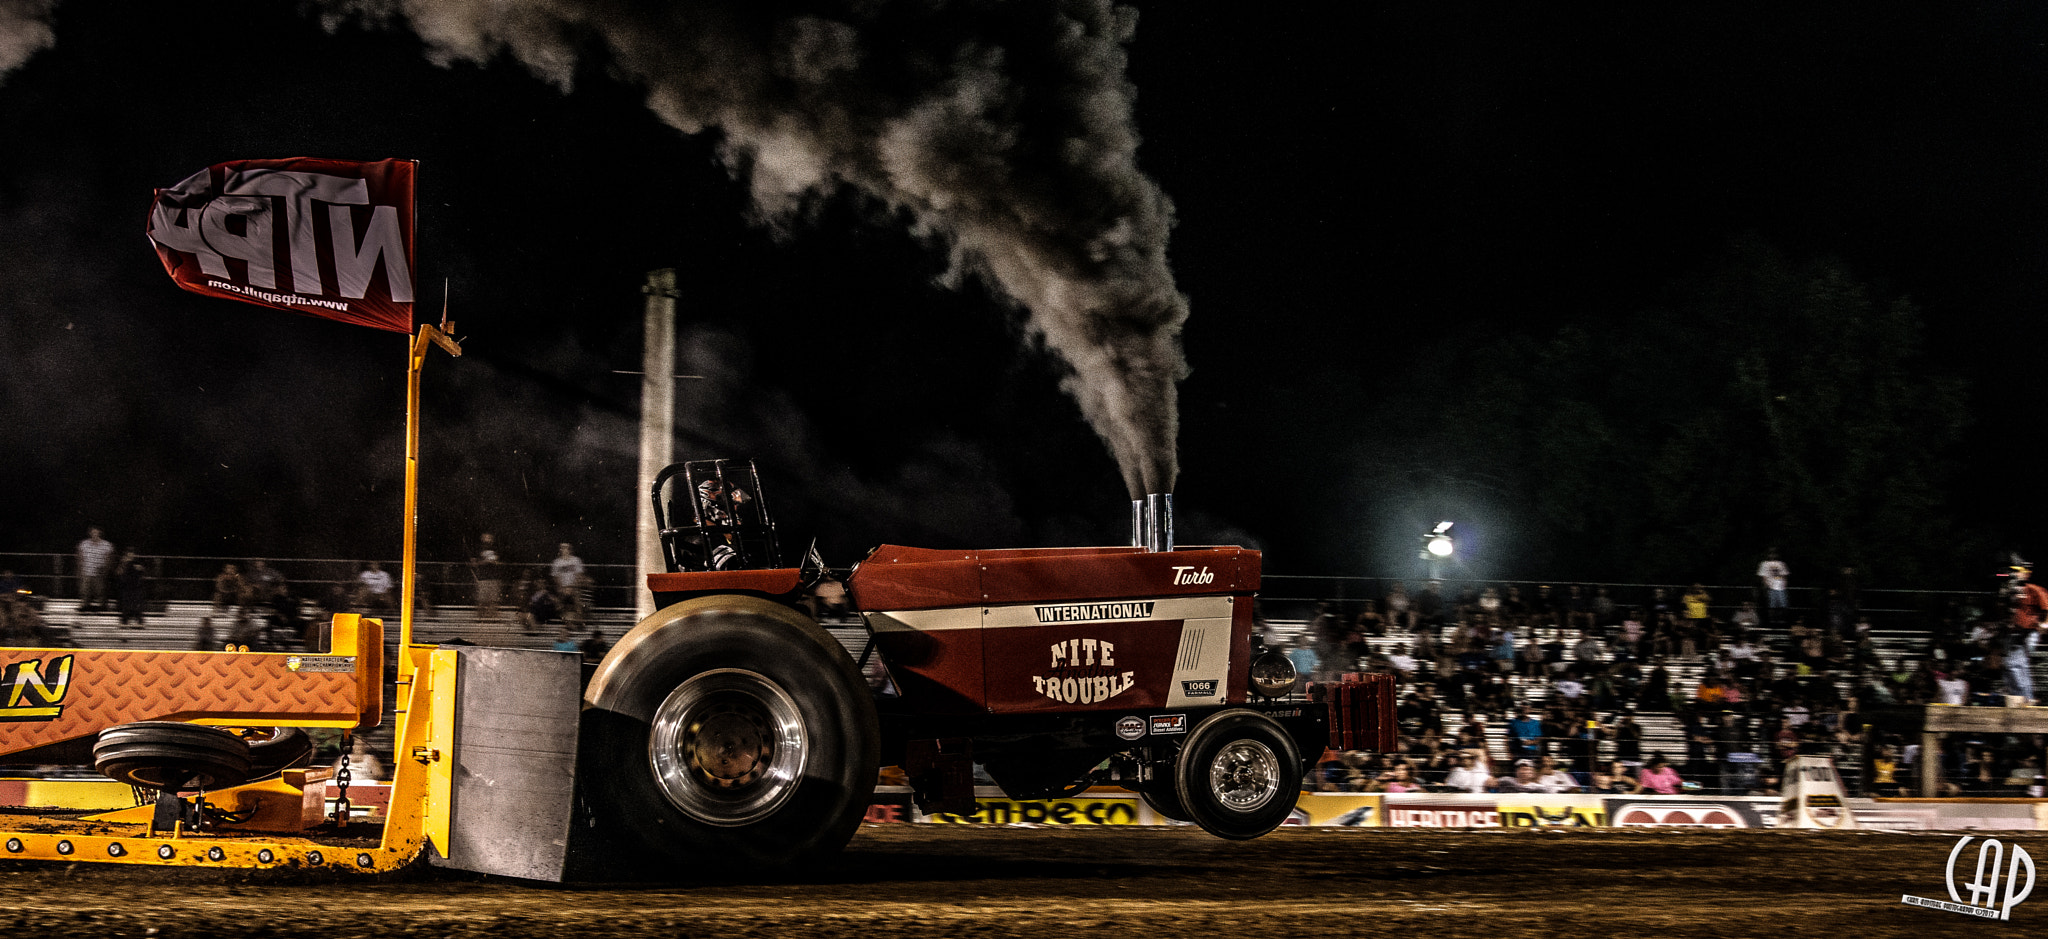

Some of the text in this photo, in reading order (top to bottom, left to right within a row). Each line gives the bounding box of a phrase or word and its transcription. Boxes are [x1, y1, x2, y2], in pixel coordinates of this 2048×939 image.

[1172, 566, 1214, 585] Turbo
[1039, 603, 1151, 622] INTERNATIONAL
[1051, 638, 1115, 668] NITE
[1042, 658, 1121, 680] Another
[1032, 670, 1135, 705] TROUBLE
[1189, 682, 1210, 690] 1066
[1265, 710, 1292, 718] CASE
[1389, 809, 1499, 827] HERITAGE
[1500, 810, 1607, 827] IRN
